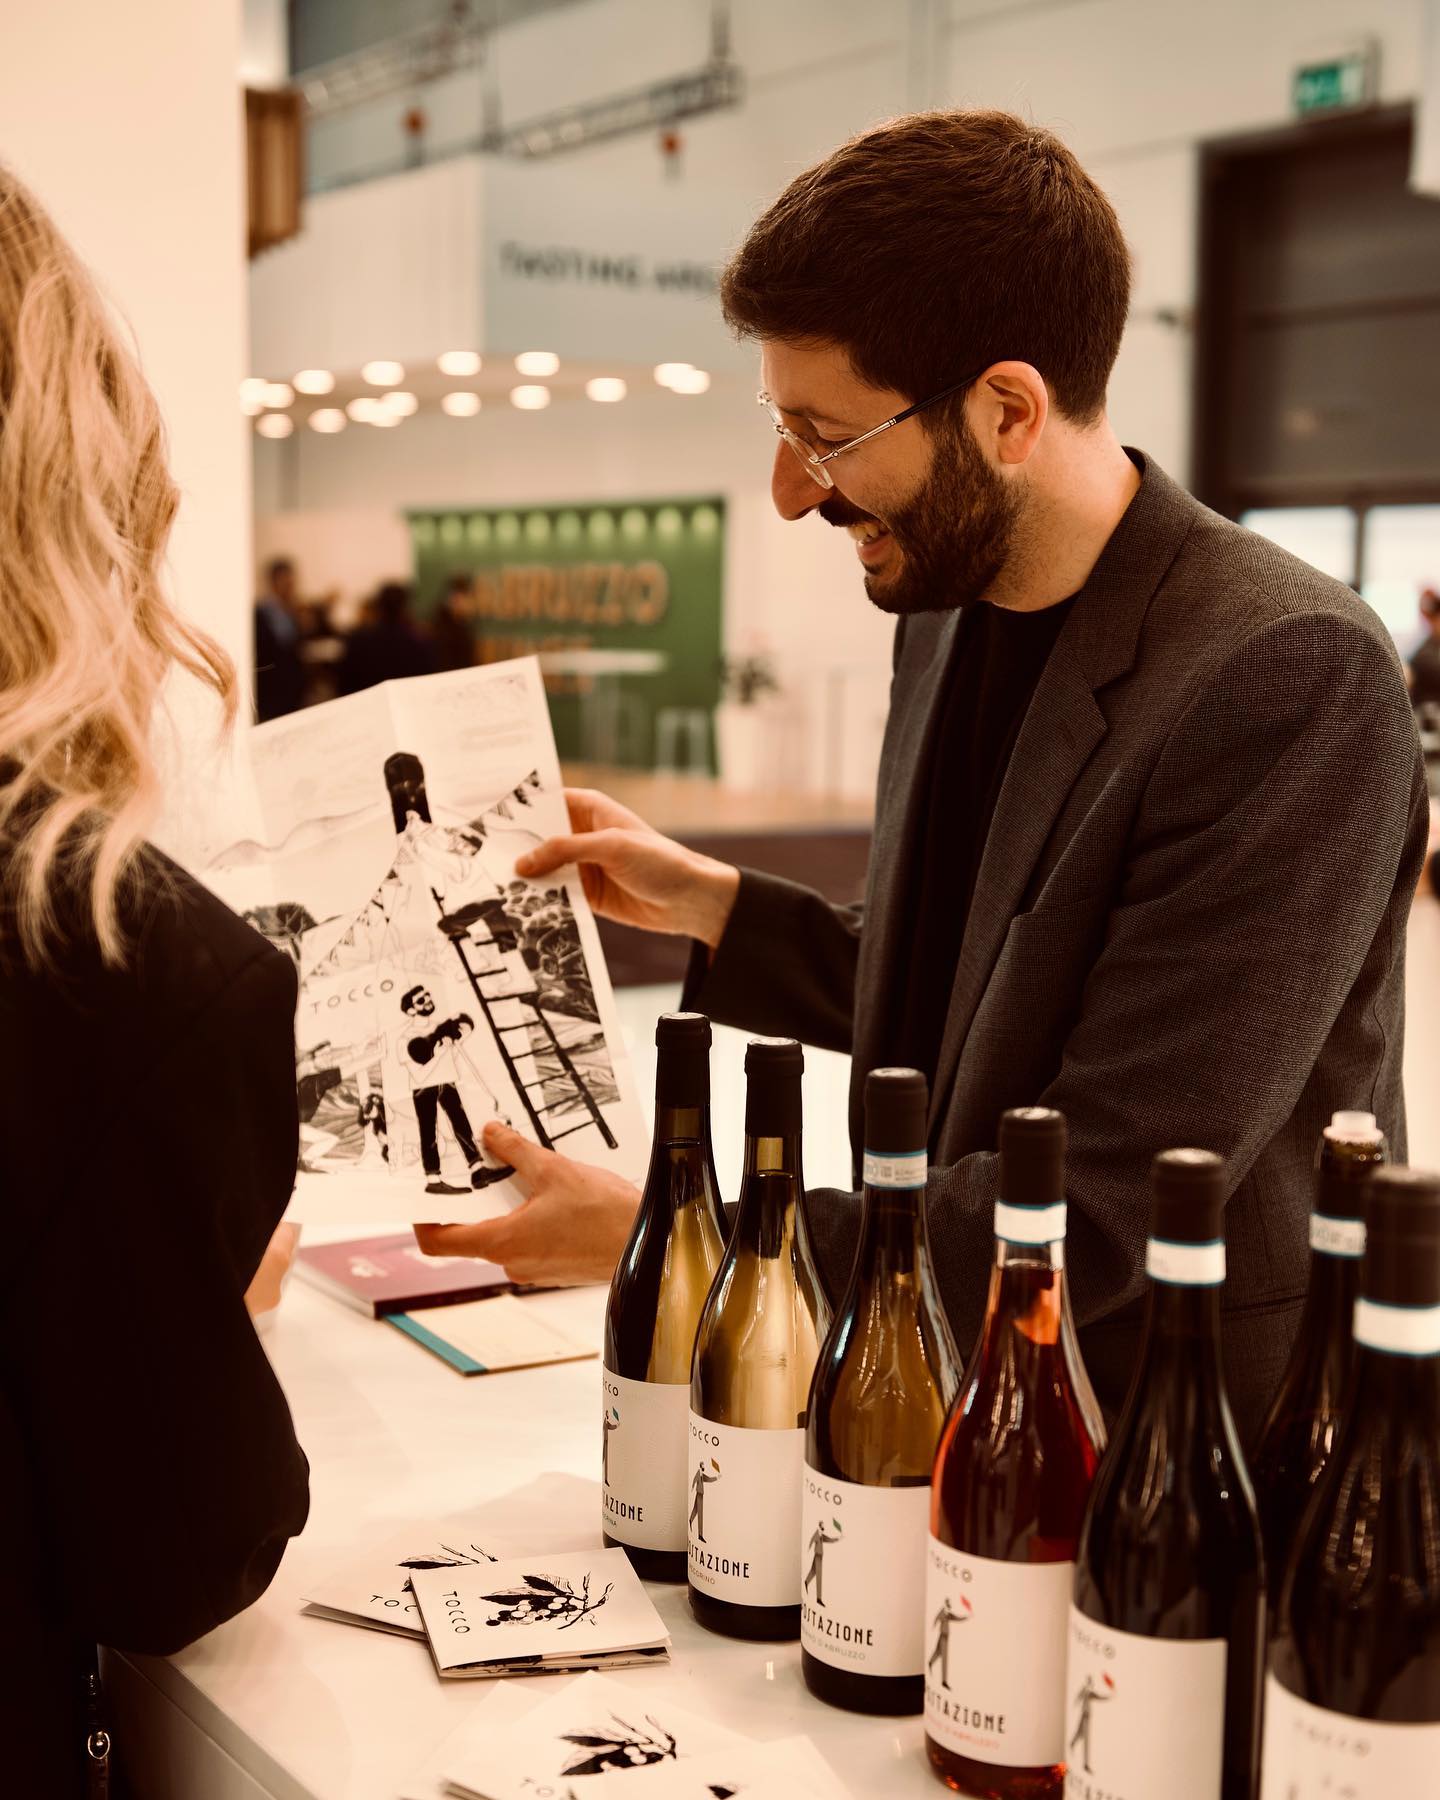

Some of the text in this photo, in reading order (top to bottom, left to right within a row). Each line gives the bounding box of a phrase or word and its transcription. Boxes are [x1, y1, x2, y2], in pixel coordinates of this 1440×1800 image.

[310, 979, 395, 1015] TOCCO
[602, 1377, 619, 1397] CCO
[441, 1590, 471, 1634] TOCCO
